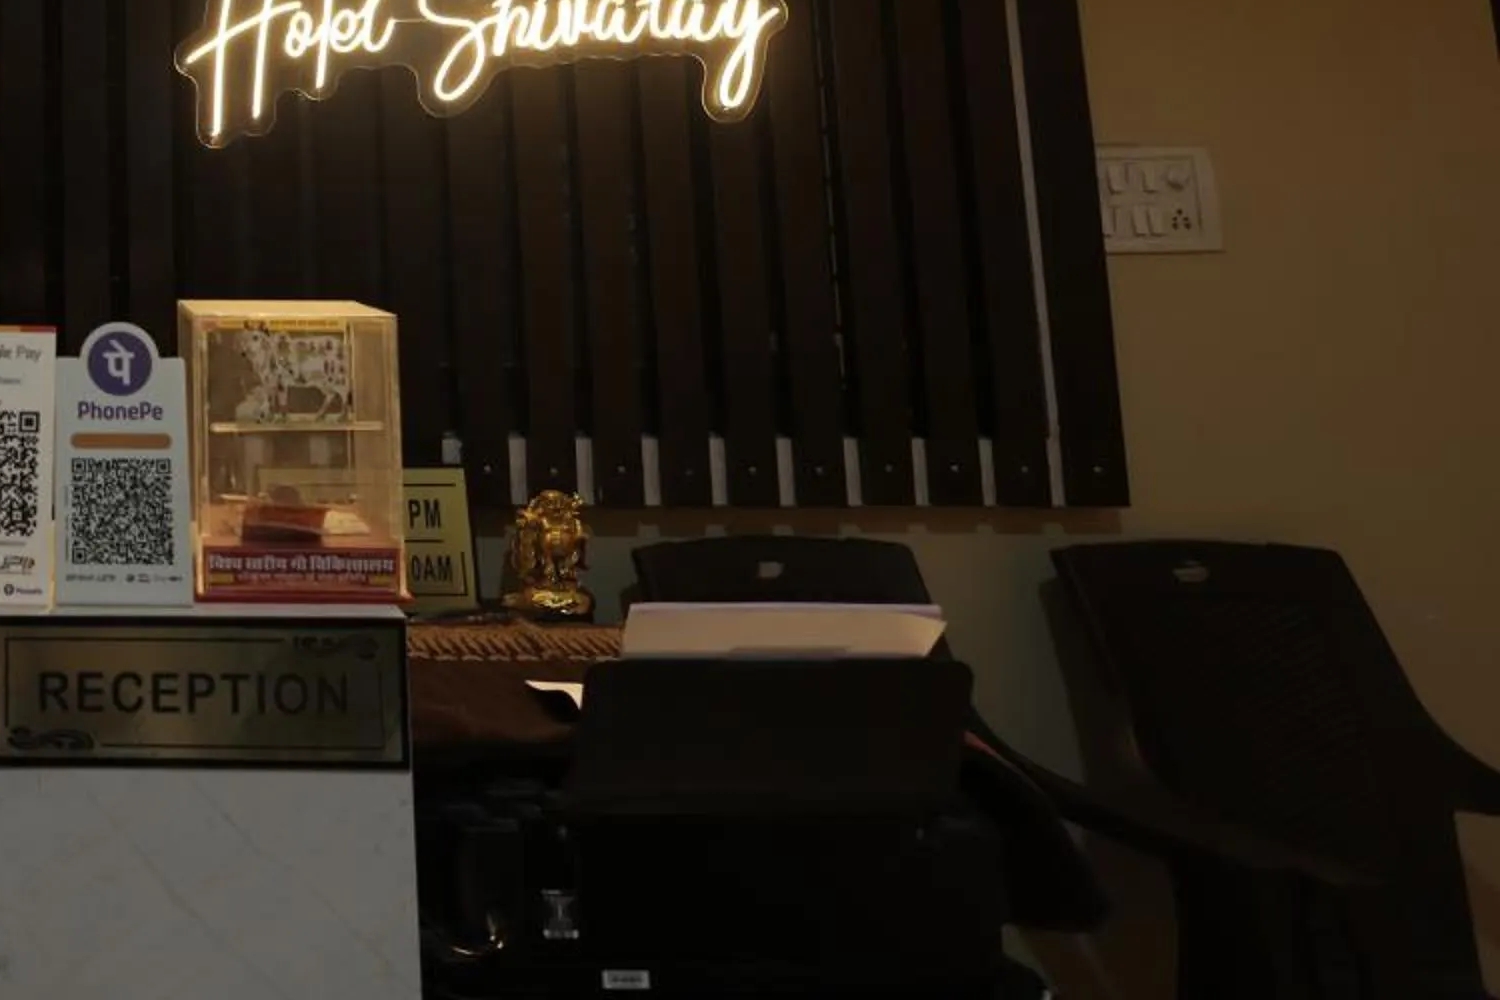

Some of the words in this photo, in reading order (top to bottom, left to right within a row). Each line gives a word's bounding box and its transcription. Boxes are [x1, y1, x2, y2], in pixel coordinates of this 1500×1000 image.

[15, 344, 42, 363] Pay
[76, 400, 164, 421] PhonePe
[407, 498, 442, 530] PM
[37, 671, 349, 715] RECEPTION
